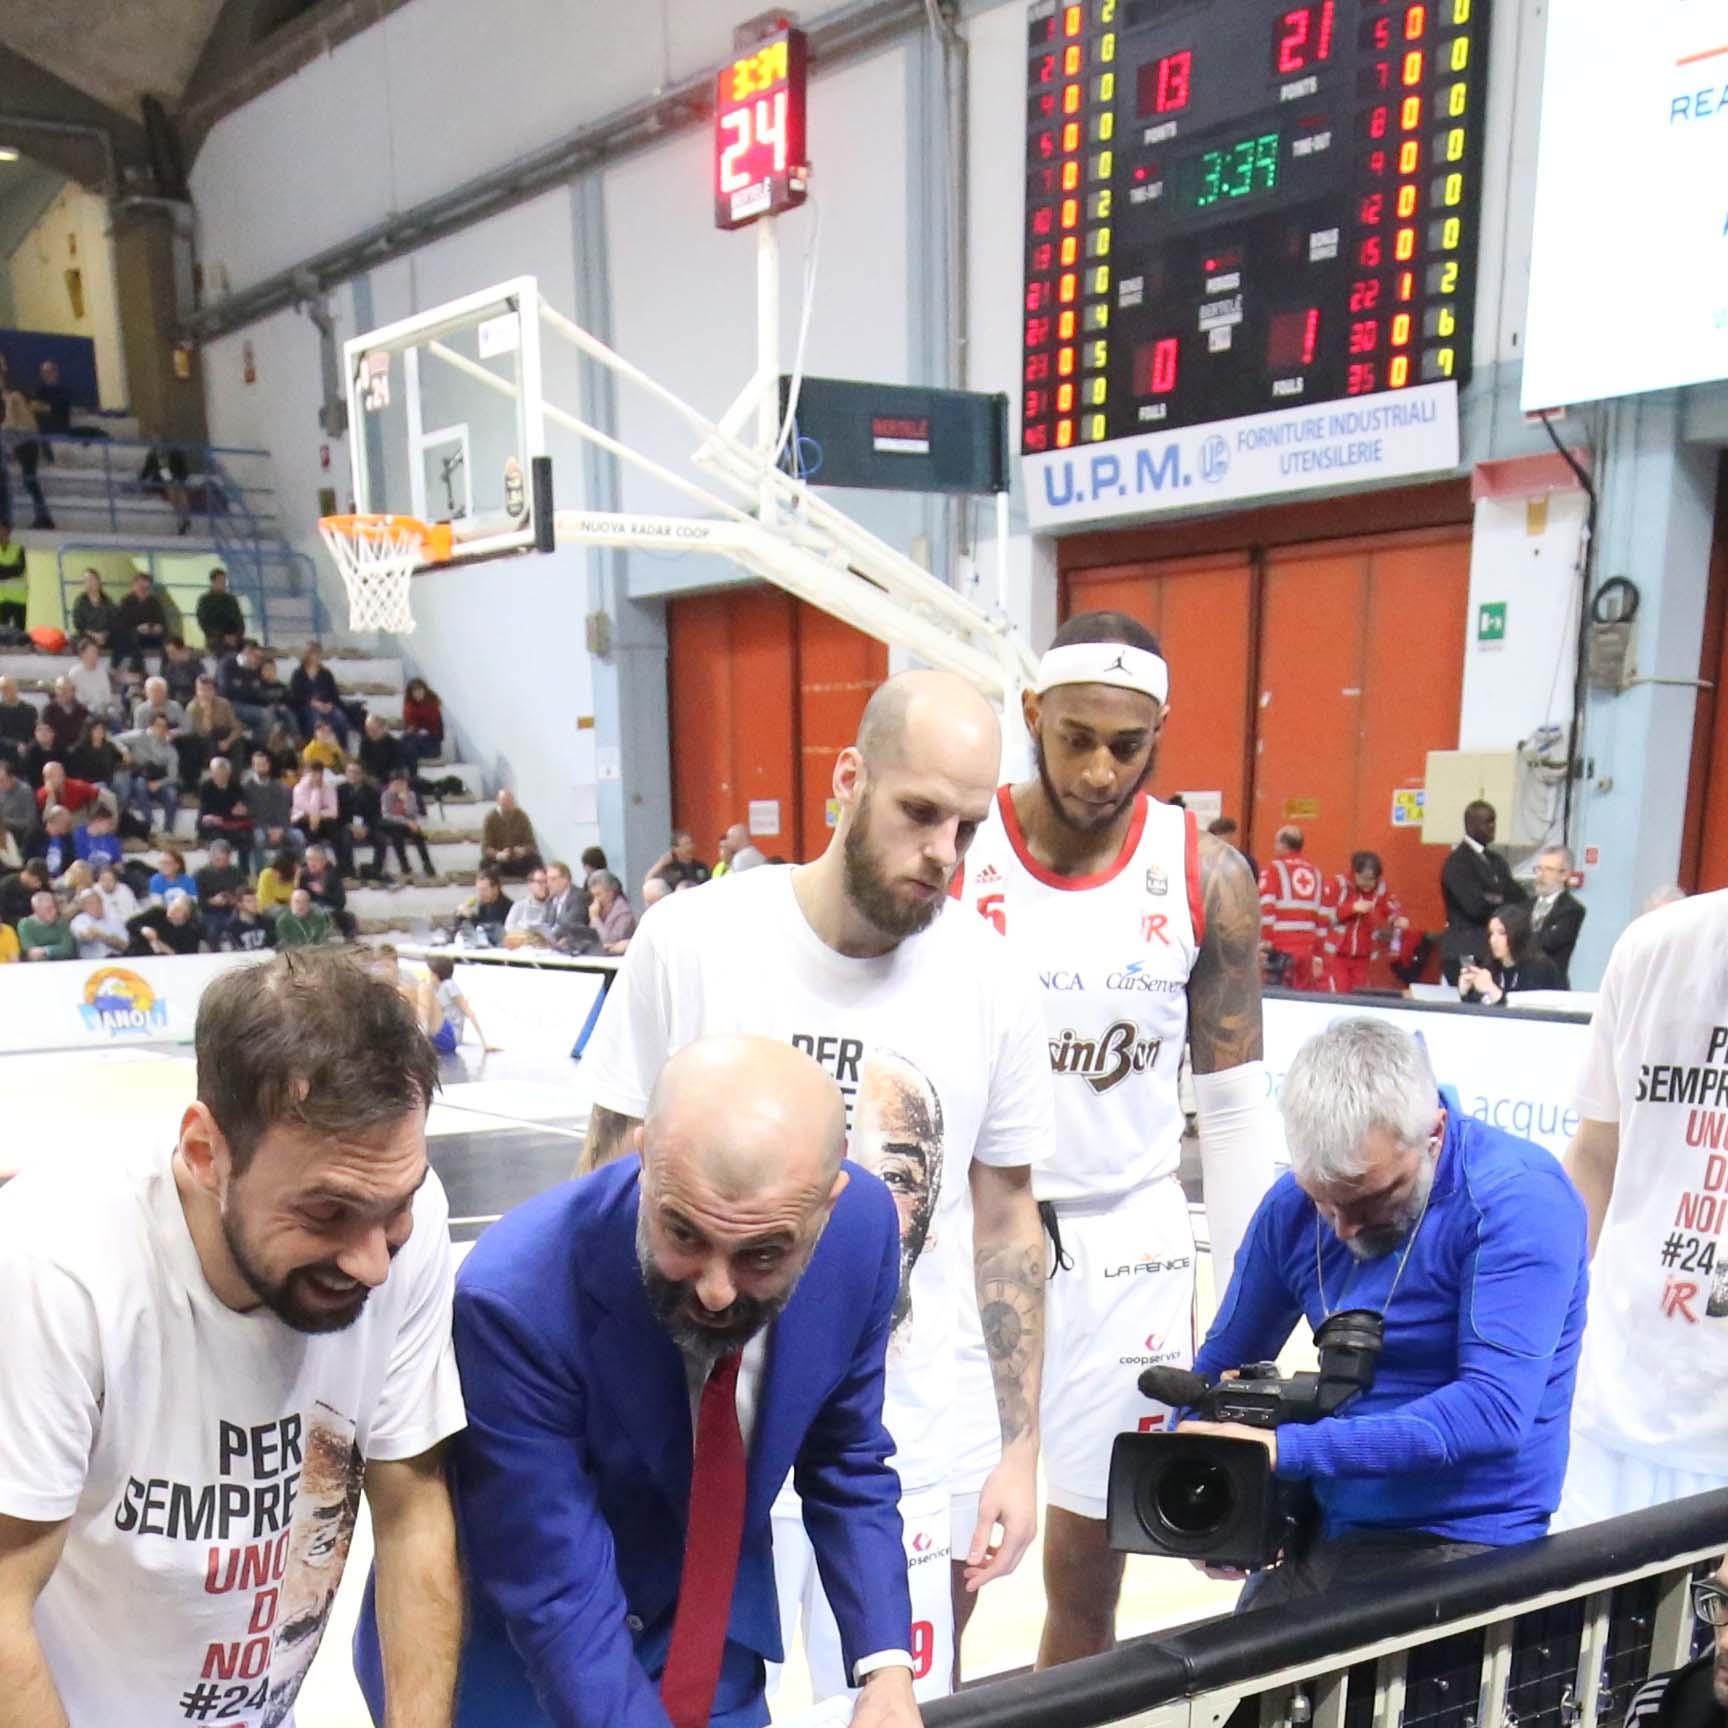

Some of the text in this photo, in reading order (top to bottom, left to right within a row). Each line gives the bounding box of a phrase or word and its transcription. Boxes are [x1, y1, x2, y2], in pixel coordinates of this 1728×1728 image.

[1066, 5, 1081, 36] 0
[1279, 0, 1334, 73] 21
[1406, 6, 1424, 40] 0
[1065, 45, 1080, 75] 0
[1100, 33, 1114, 62] 0
[1403, 51, 1422, 86] 0
[1064, 85, 1080, 114] 0
[1099, 73, 1114, 101] 0
[1157, 51, 1191, 113] 13
[1063, 112, 1113, 152] 0 0
[1401, 96, 1420, 130] 0
[721, 92, 786, 193] 24
[1400, 141, 1417, 174] 0
[1063, 151, 1112, 190] 0 0
[1198, 134, 1278, 206] 3:39
[1061, 190, 1111, 228] 0 2
[1398, 185, 1415, 217] 0
[1061, 237, 1076, 265] 0
[1095, 228, 1110, 255] 0
[1396, 228, 1414, 260] 0
[1059, 274, 1076, 302] 0
[1094, 266, 1109, 293] 0
[1350, 279, 1381, 313] 22
[1400, 273, 1412, 301] 1
[1059, 311, 1074, 339] 0
[1095, 304, 1108, 327] 4
[1303, 309, 1319, 365] 1
[1391, 314, 1410, 346] 0
[1059, 348, 1073, 376] 0
[1094, 341, 1106, 367] 5
[1153, 338, 1178, 393] 0
[1390, 356, 1407, 387] 0
[1057, 384, 1072, 412] 0
[1093, 377, 1106, 404] 0
[1057, 420, 1072, 448] 0
[1092, 415, 1105, 440] 0
[1237, 400, 1437, 451] FORNITURE INDUSTRIALI
[1044, 445, 1191, 507] U.P.M.
[1281, 439, 1382, 475] UTENSILERIE
[581, 520, 710, 538] NUOVA RADAR COOP
[1040, 972, 1085, 991] NCA
[1473, 1094, 1580, 1138] acque
[1675, 1193, 1728, 1234] NOI
[1104, 1257, 1190, 1277] LA FENICE
[1661, 1234, 1717, 1276] #24
[219, 1413, 302, 1480] PER
[115, 1471, 300, 1542] SEMPRE
[204, 1531, 290, 1595] UNO
[180, 1682, 269, 1720] #24
